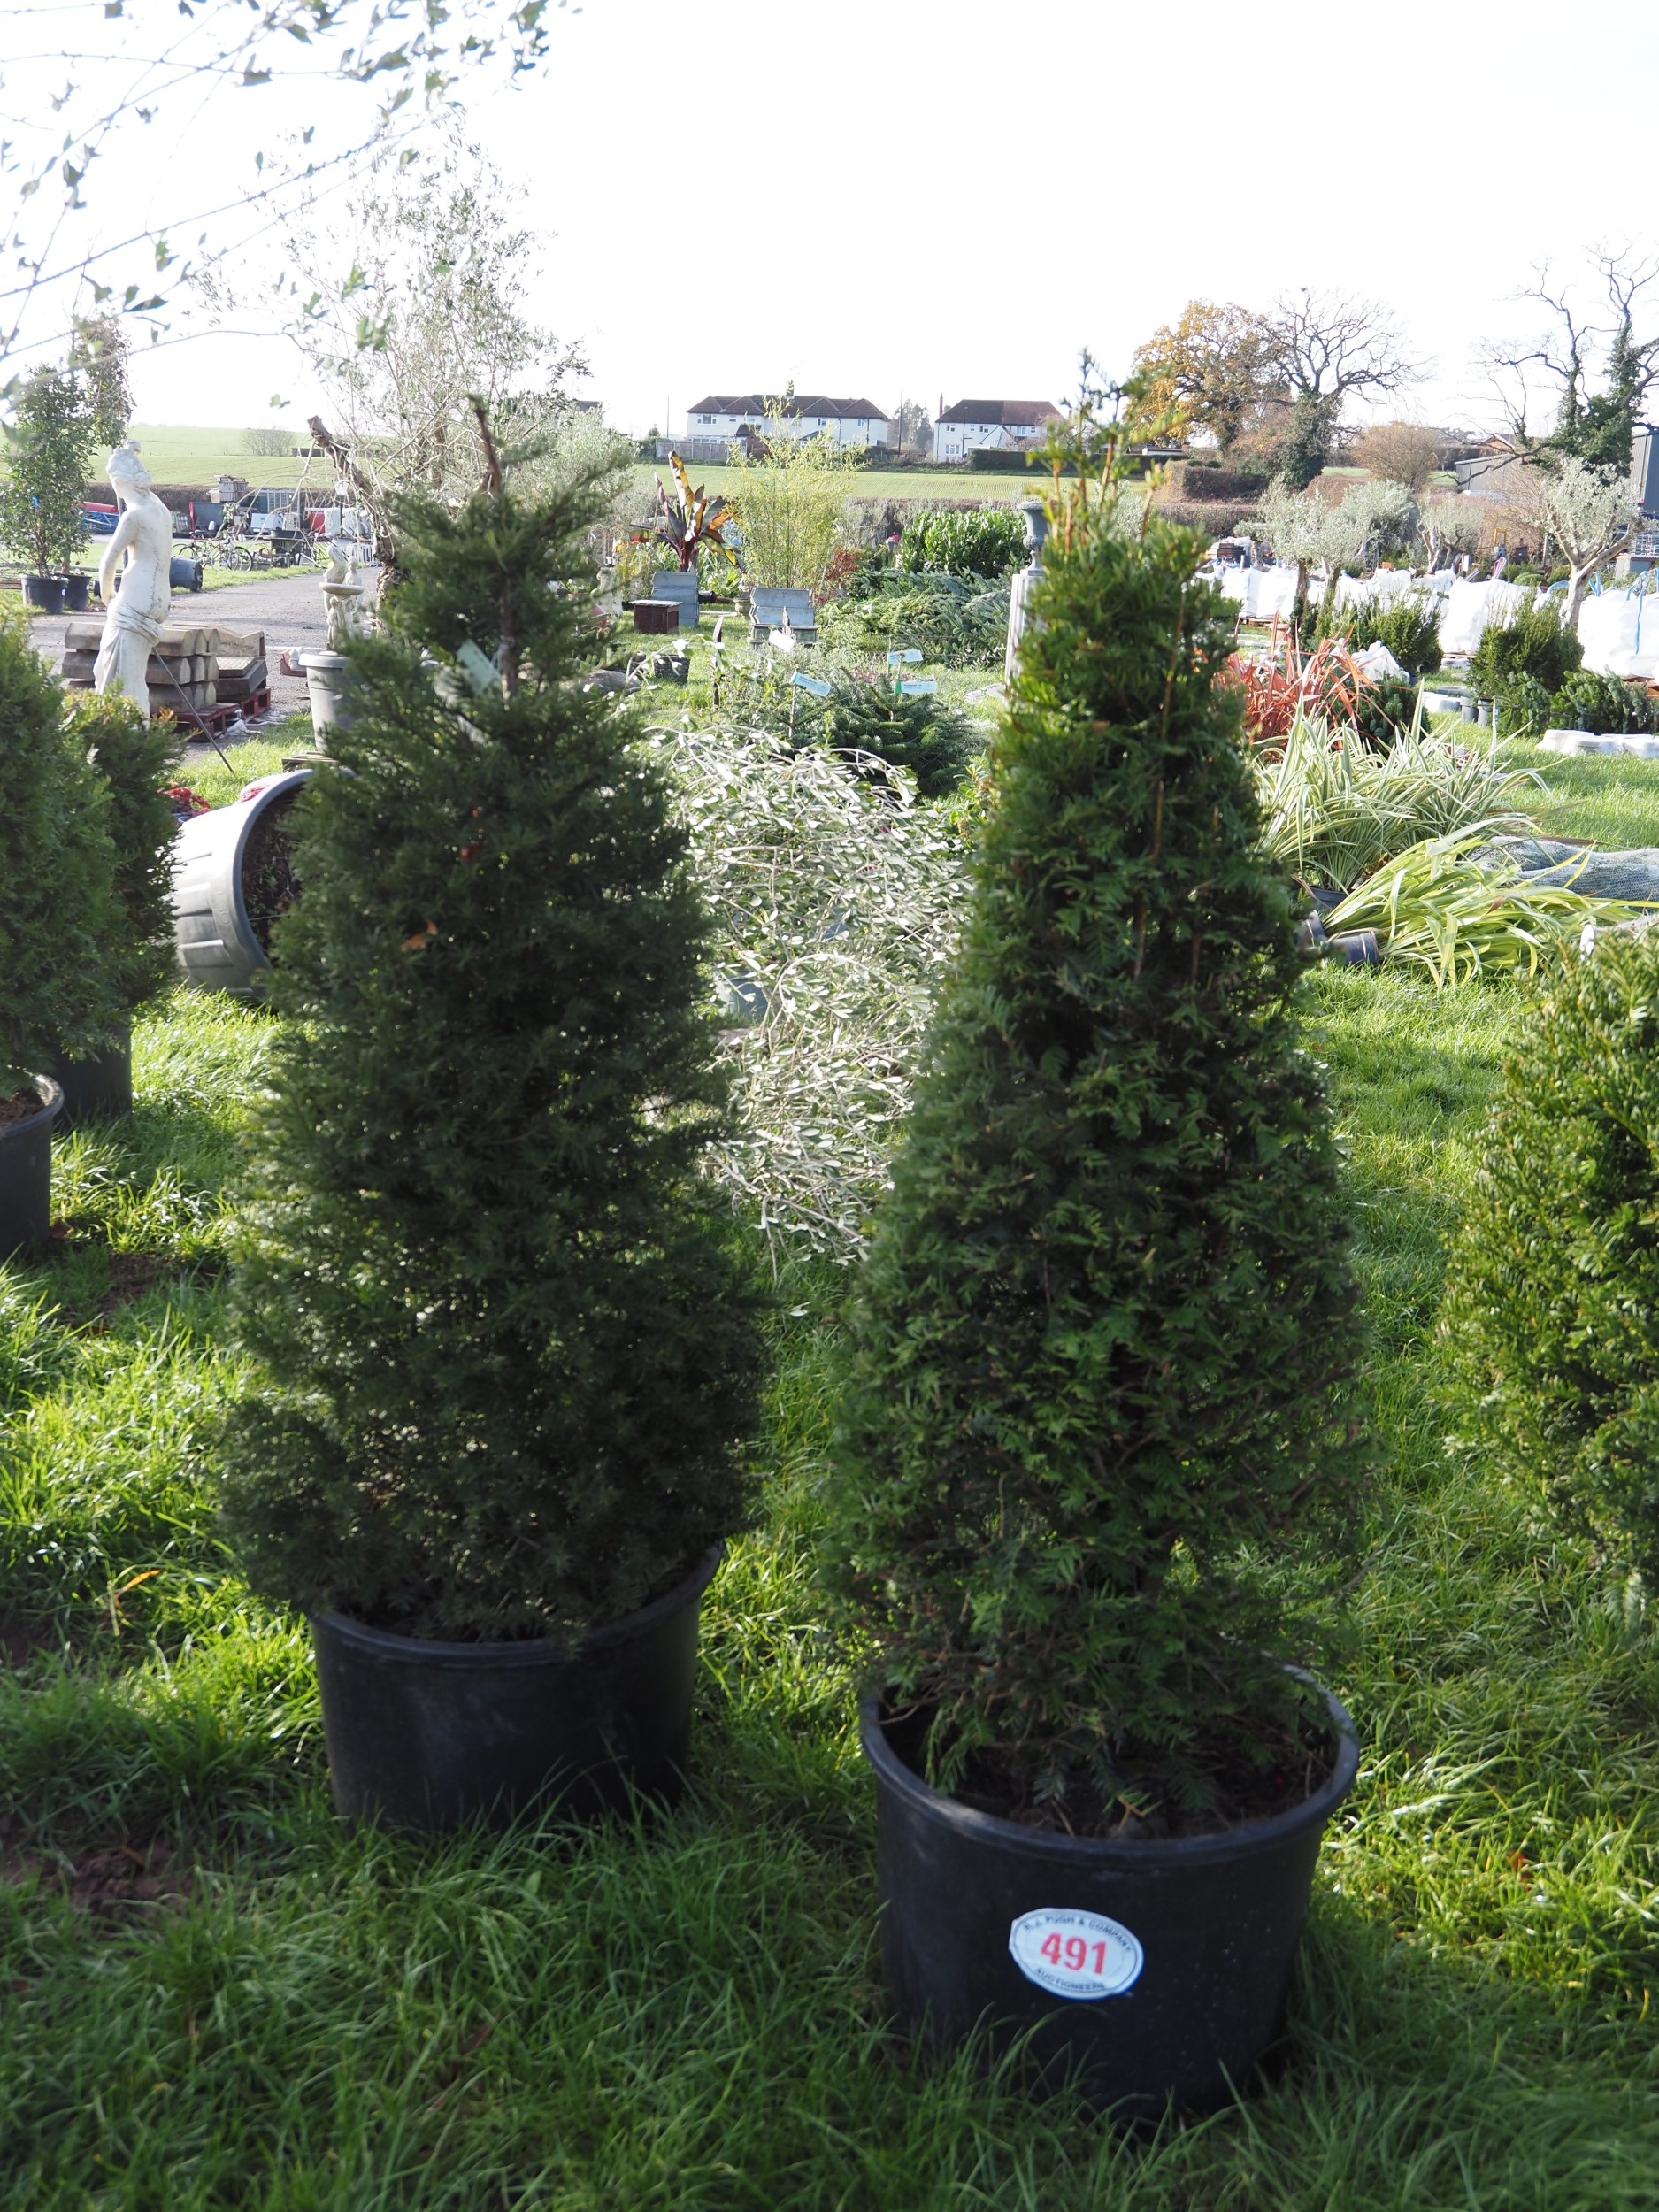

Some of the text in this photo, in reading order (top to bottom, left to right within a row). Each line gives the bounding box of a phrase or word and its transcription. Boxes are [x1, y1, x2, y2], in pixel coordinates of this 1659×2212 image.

[1089, 1919, 1131, 1951] COMPANY
[1041, 1932, 1106, 1974] 491
[1036, 1968, 1105, 1990] AUCTIONEERS
